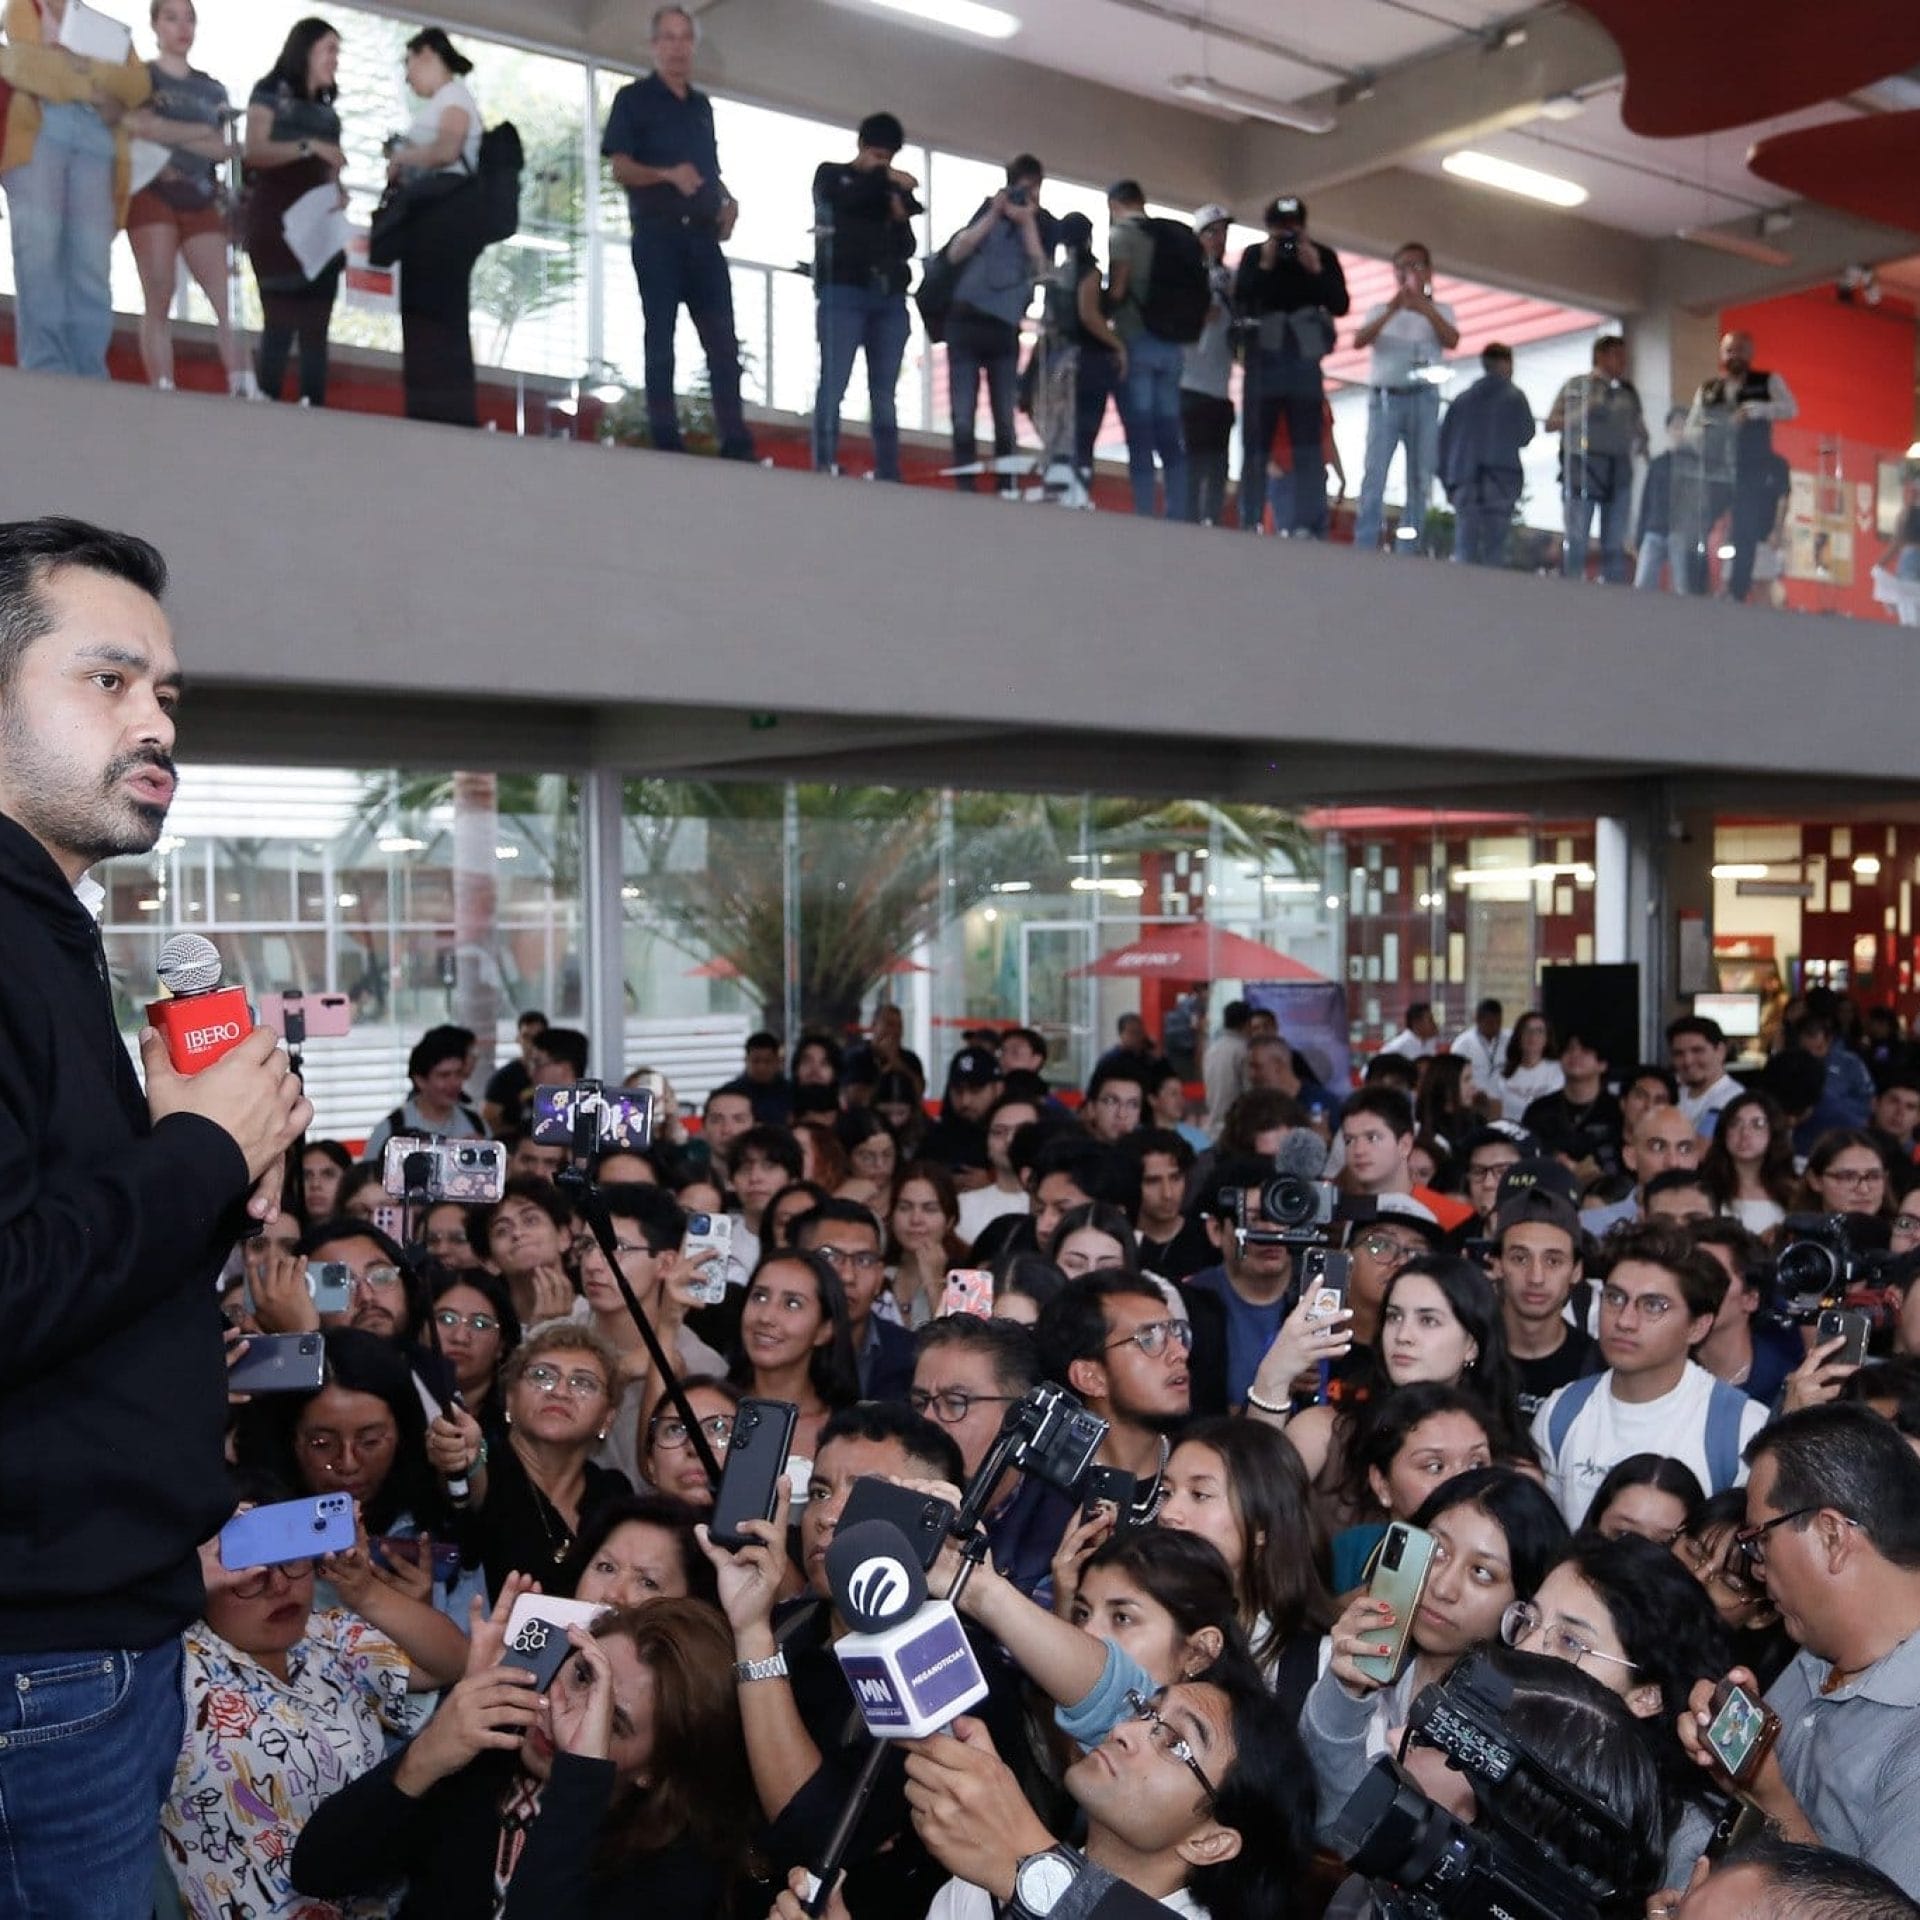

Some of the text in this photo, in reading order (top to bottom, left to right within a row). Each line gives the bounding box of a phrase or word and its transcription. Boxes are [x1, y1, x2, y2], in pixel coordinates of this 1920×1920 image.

[184, 1021, 240, 1049] IBERO
[911, 1647, 966, 1688] MEGANOTICIAS
[856, 1678, 893, 1703] MN
